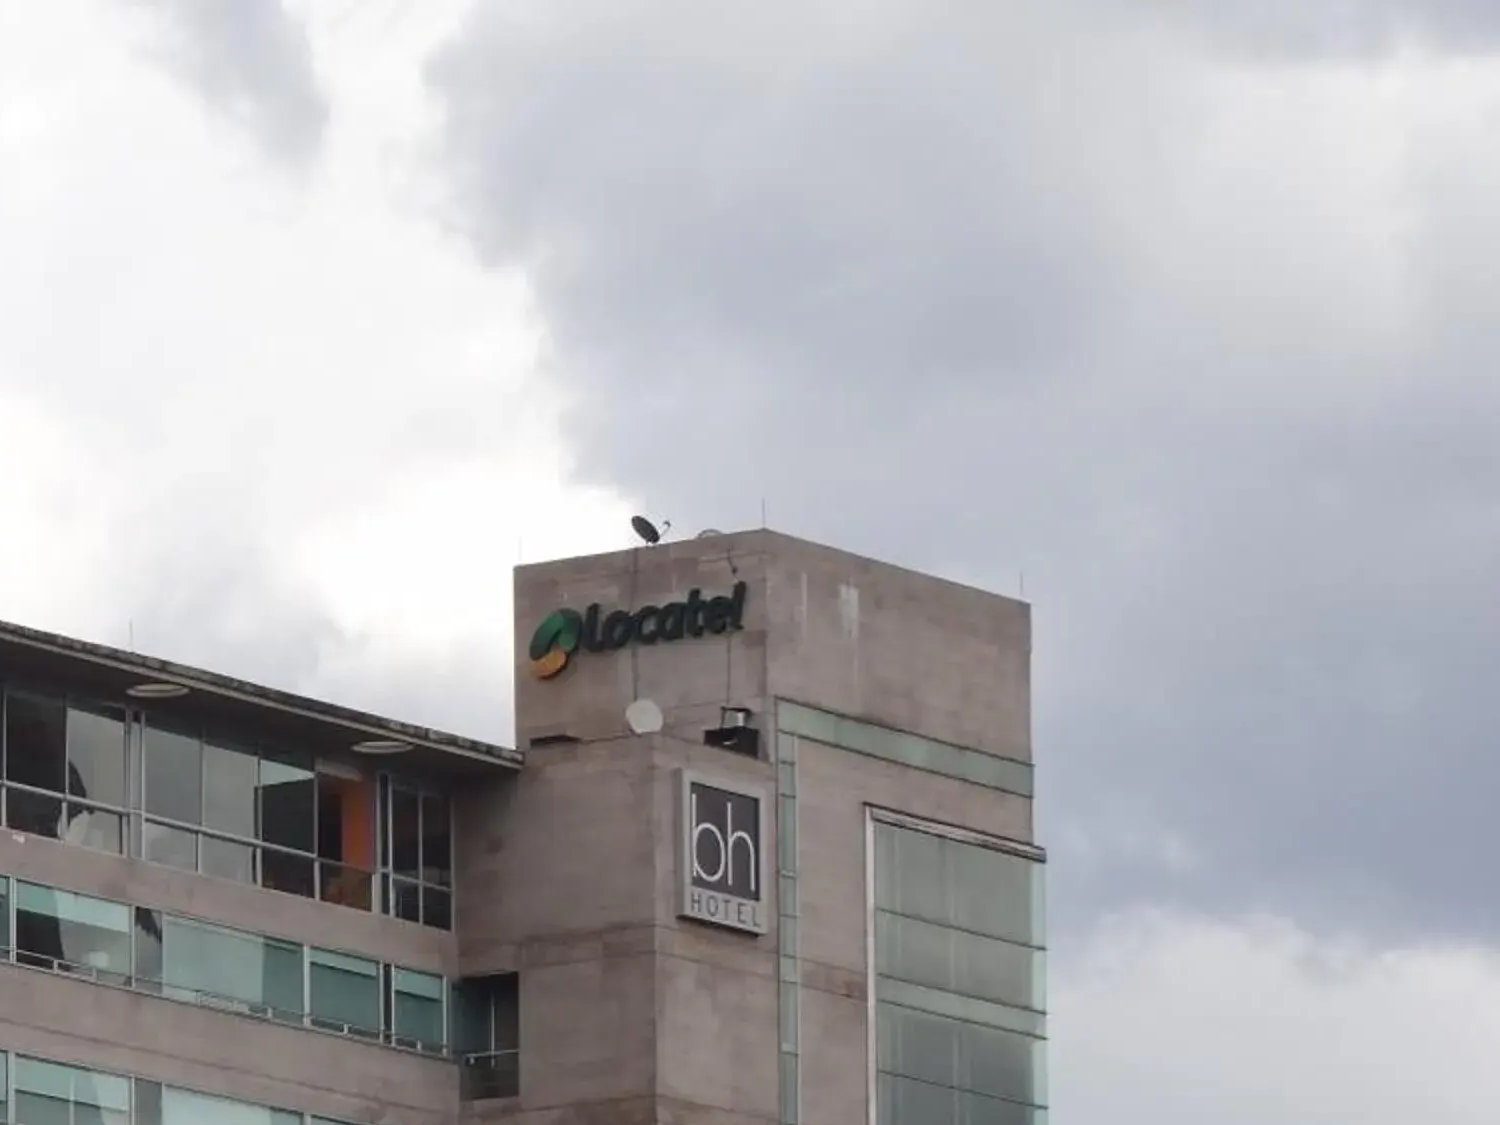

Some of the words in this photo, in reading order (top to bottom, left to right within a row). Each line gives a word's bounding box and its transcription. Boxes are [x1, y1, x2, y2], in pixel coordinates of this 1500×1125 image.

[584, 580, 747, 653] Locatel
[691, 793, 755, 892] bh
[691, 893, 761, 927] HOTEL
